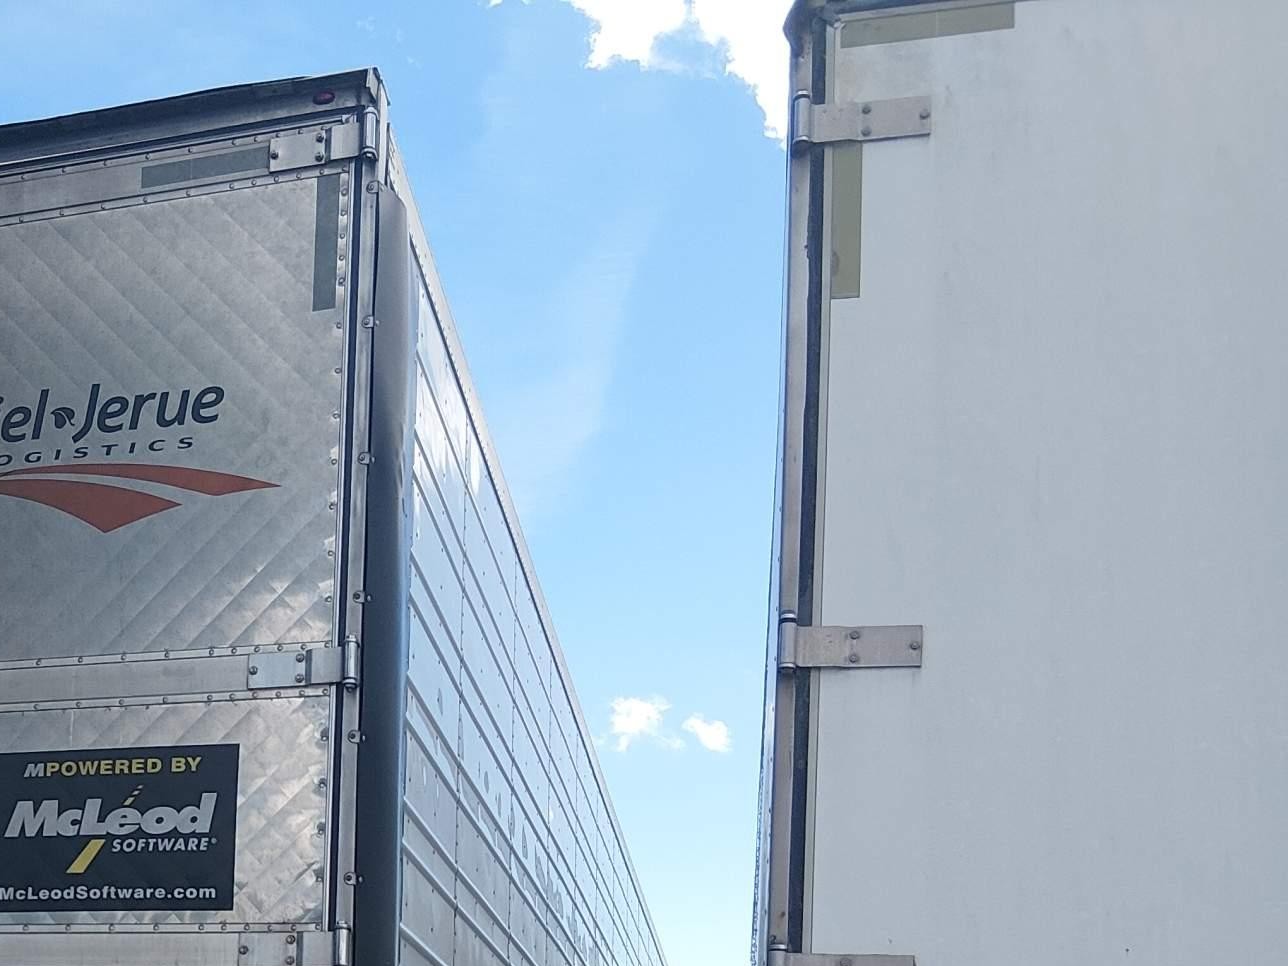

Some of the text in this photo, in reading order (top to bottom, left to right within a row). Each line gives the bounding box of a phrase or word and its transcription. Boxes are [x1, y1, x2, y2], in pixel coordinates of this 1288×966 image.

[71, 383, 225, 444] Jerue
[23, 756, 202, 778] MPOWERED BY
[112, 837, 210, 852] SOFTWARE
